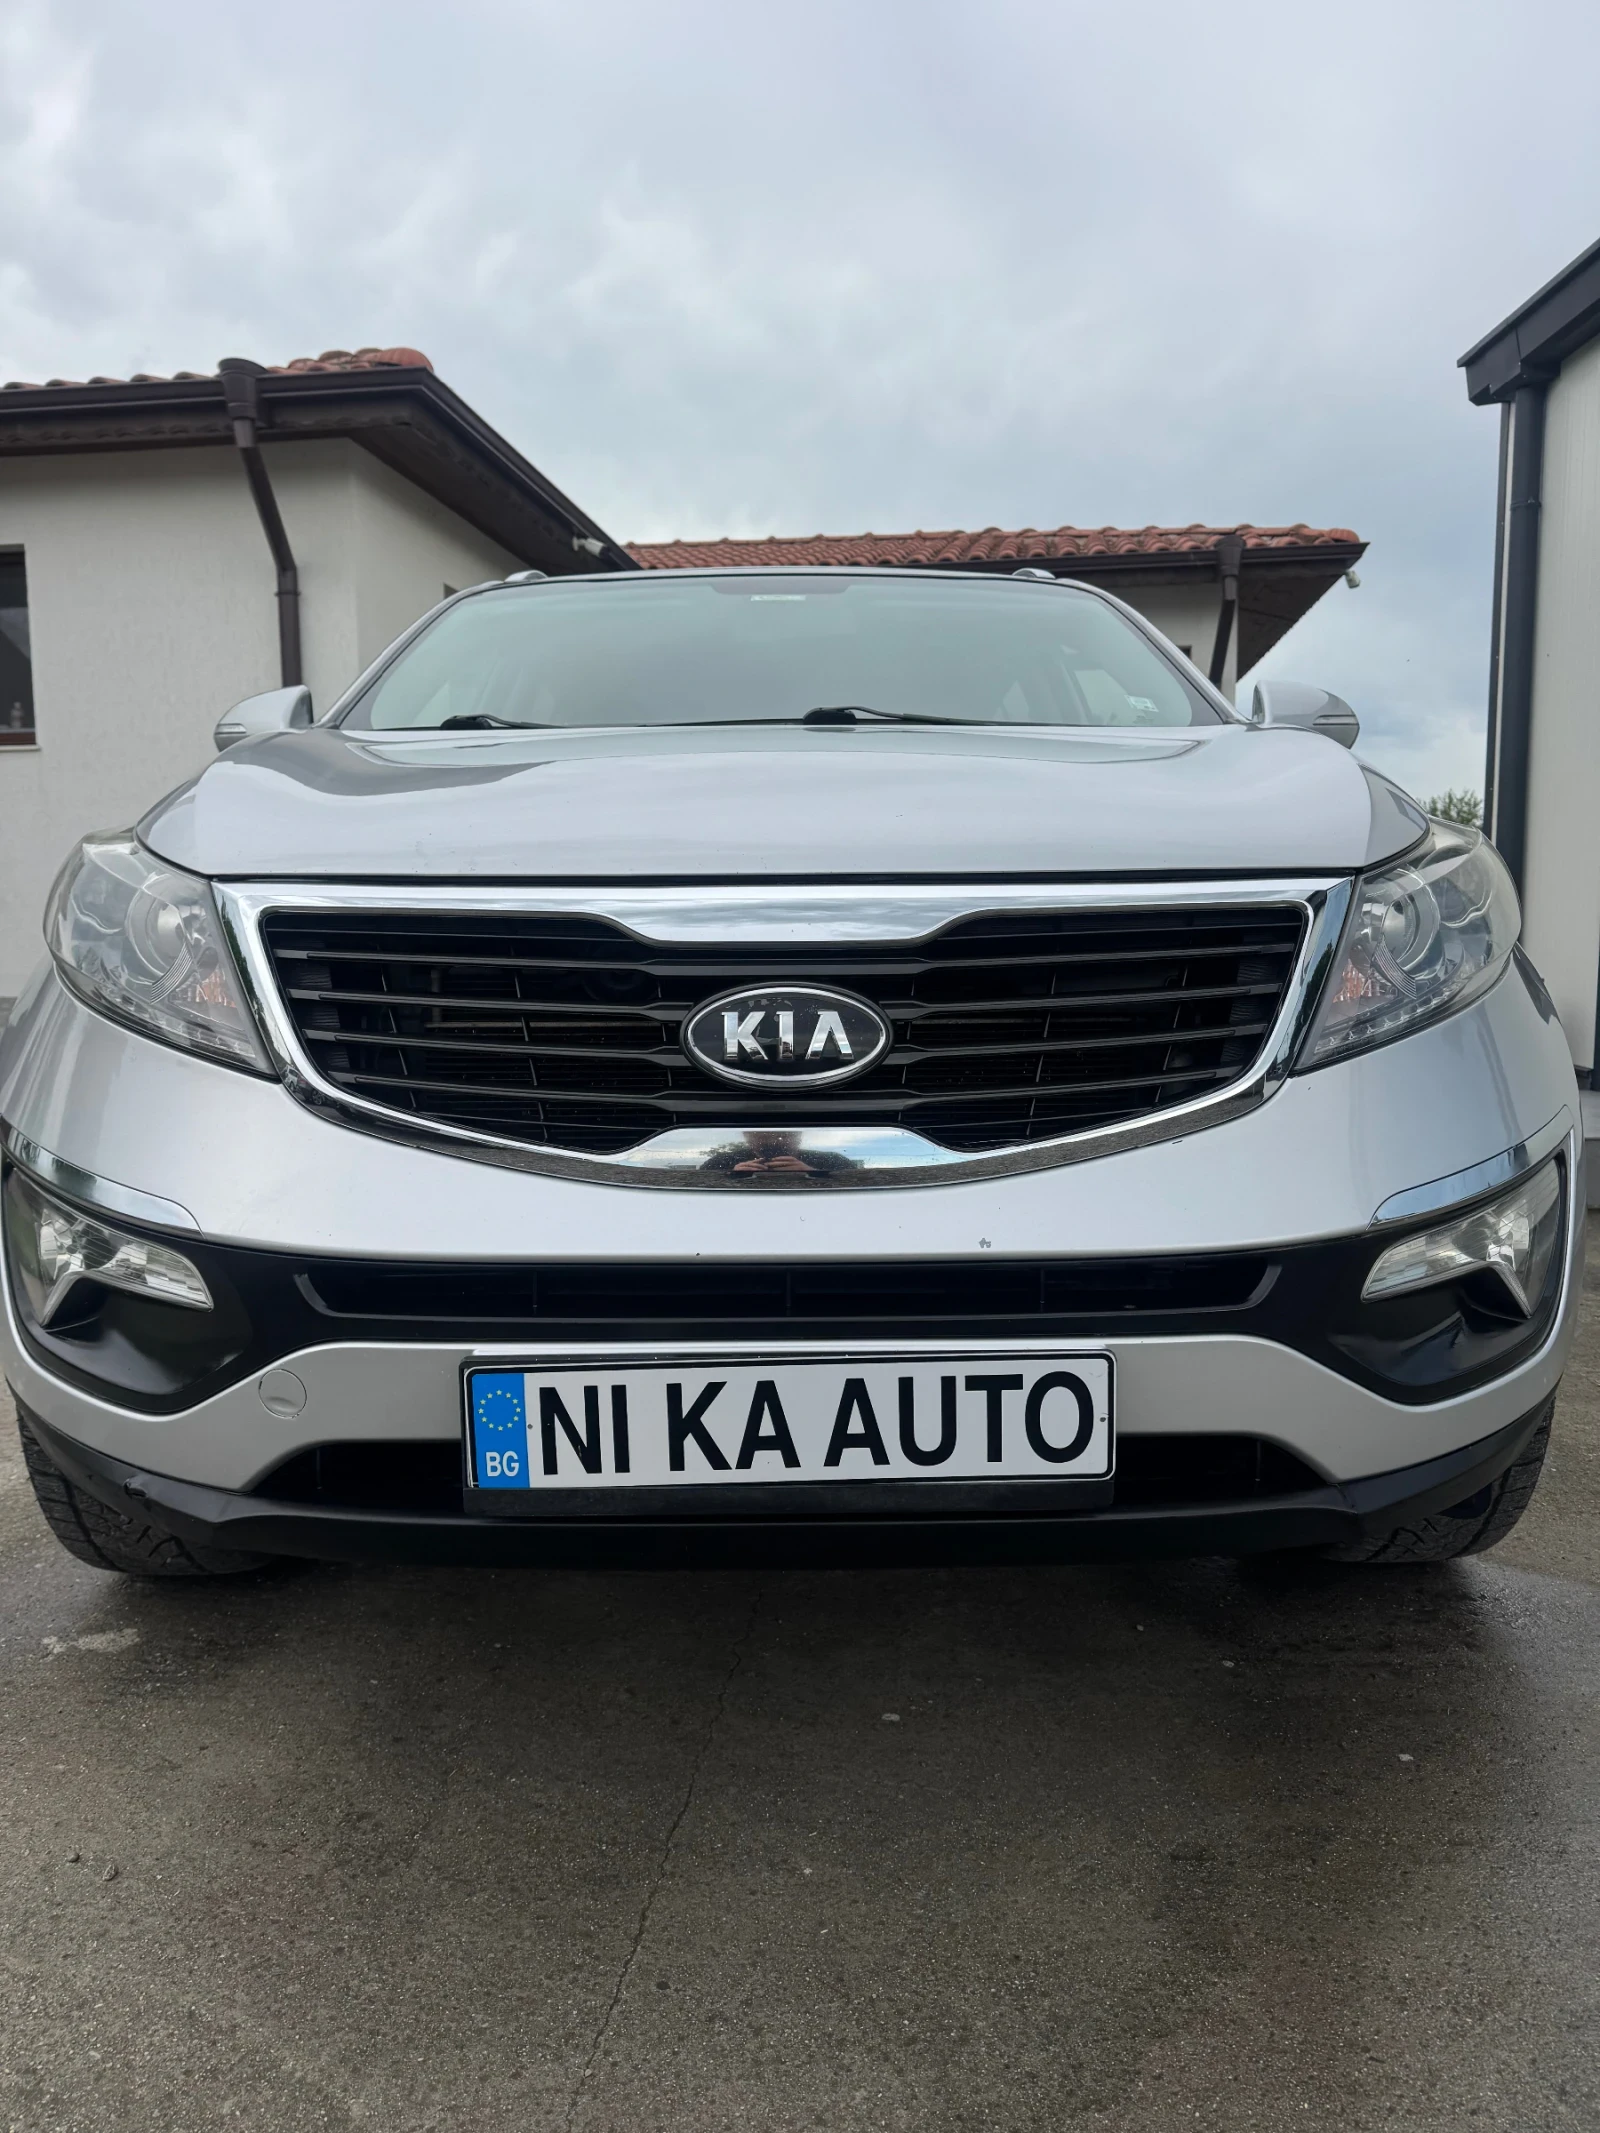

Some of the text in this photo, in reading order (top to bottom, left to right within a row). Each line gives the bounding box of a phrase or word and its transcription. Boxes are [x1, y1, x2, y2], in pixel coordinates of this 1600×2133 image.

[721, 1011, 855, 1060] KIA
[539, 1370, 1095, 1476] NI KA AUTO
[485, 1450, 520, 1477] BG
